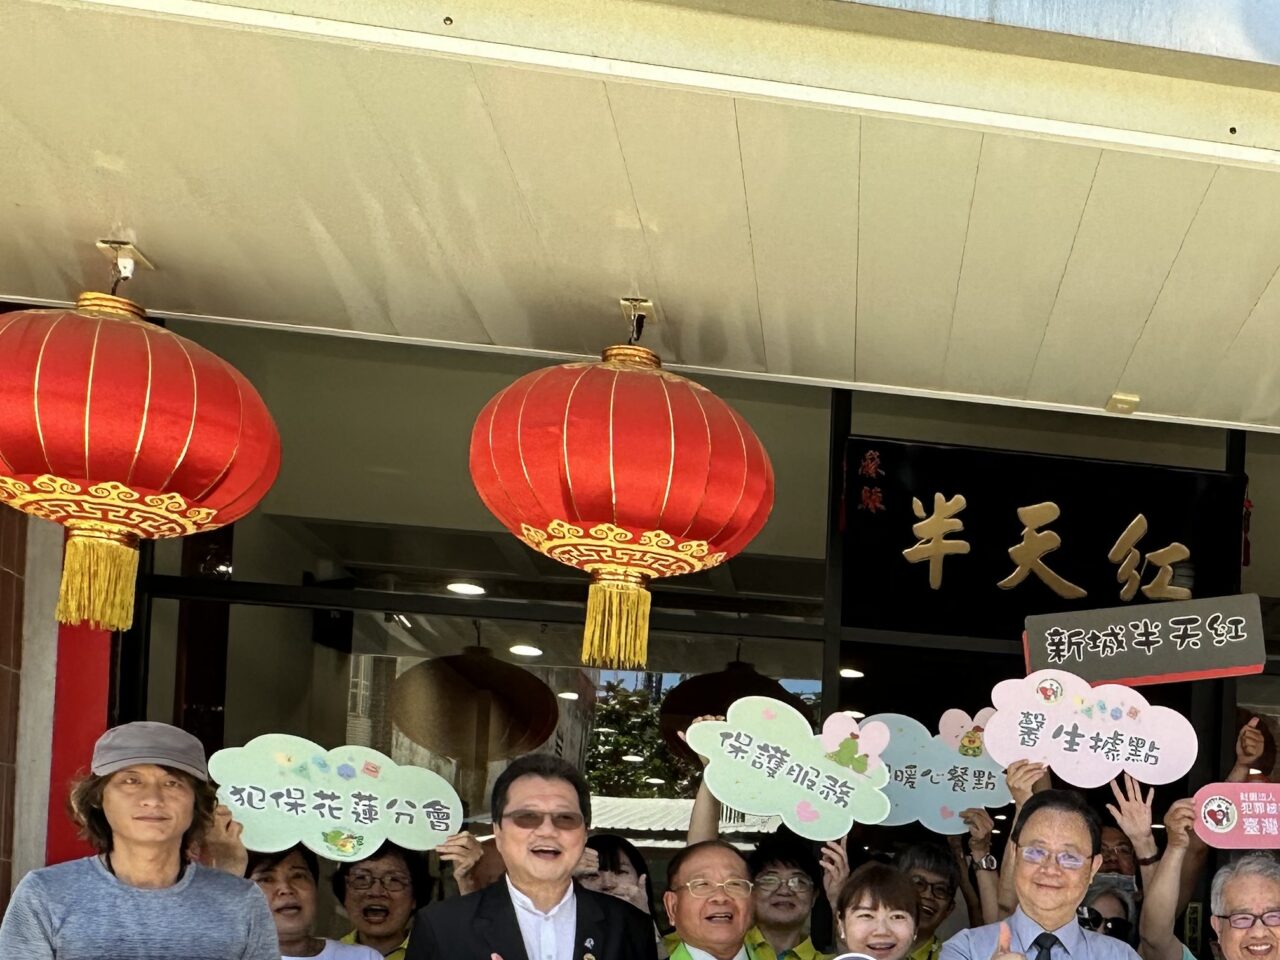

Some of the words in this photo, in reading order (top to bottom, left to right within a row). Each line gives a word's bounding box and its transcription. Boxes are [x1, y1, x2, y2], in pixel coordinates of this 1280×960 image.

[902, 492, 1192, 602] 半天紅
[1045, 613, 1248, 664] 新城半天紅
[719, 731, 856, 809] 保護服務
[885, 764, 997, 793] 暖心餐點
[229, 784, 452, 833] 犯保花蓮分會
